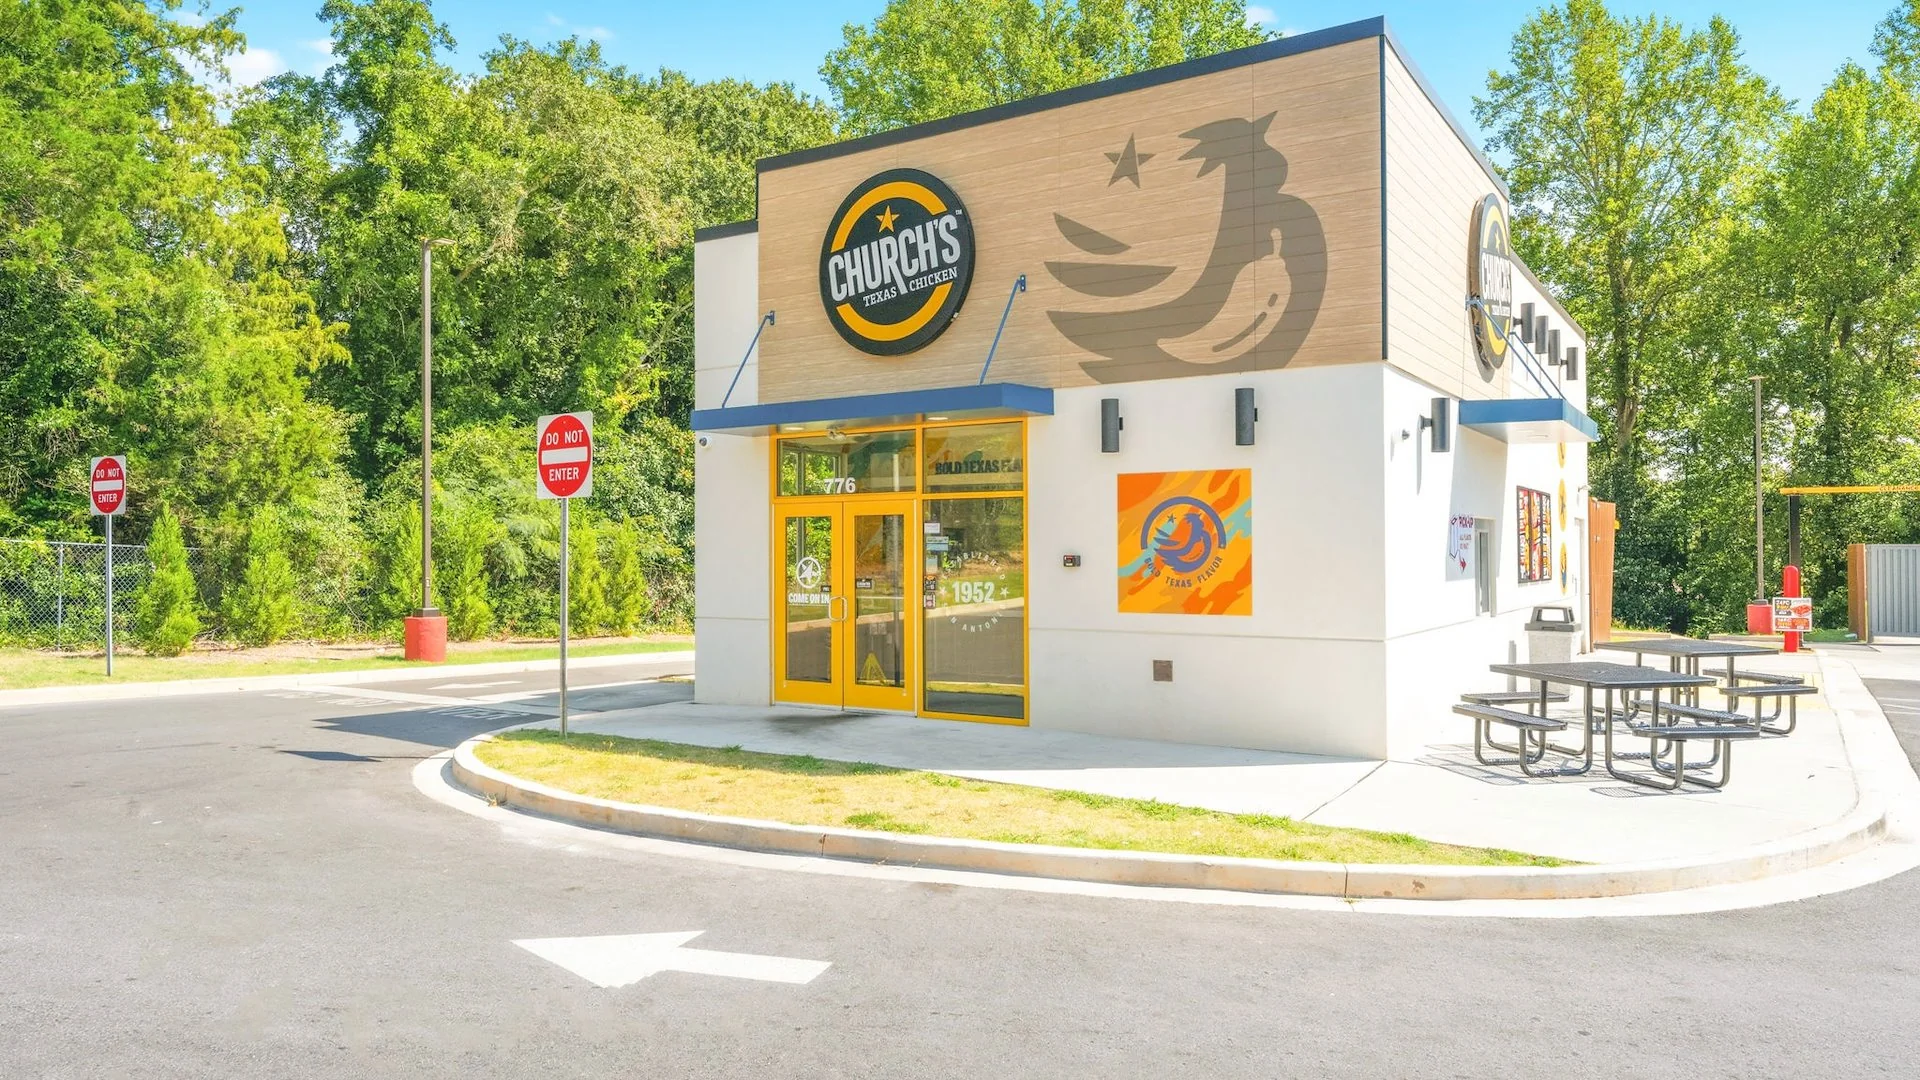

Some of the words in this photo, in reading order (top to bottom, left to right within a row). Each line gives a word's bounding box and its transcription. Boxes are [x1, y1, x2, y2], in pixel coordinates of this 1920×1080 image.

[828, 214, 961, 302] CHURCH'S
[862, 286, 897, 308] TEXAS
[909, 266, 958, 292] CHICKEN
[546, 432, 559, 446] DO
[564, 430, 583, 443] NOT
[96, 469, 104, 478] DO
[108, 468, 120, 477] NOT
[549, 467, 579, 481] ENTER
[963, 460, 999, 474] TEXAS
[823, 476, 856, 494] 776
[98, 493, 118, 503] ENTER
[1144, 557, 1161, 577] BOLD
[1165, 576, 1192, 588] TEXAS
[1197, 556, 1223, 583] FLAVOR
[788, 593, 810, 604] COME
[810, 592, 820, 604] ON
[952, 581, 995, 604] 1952
